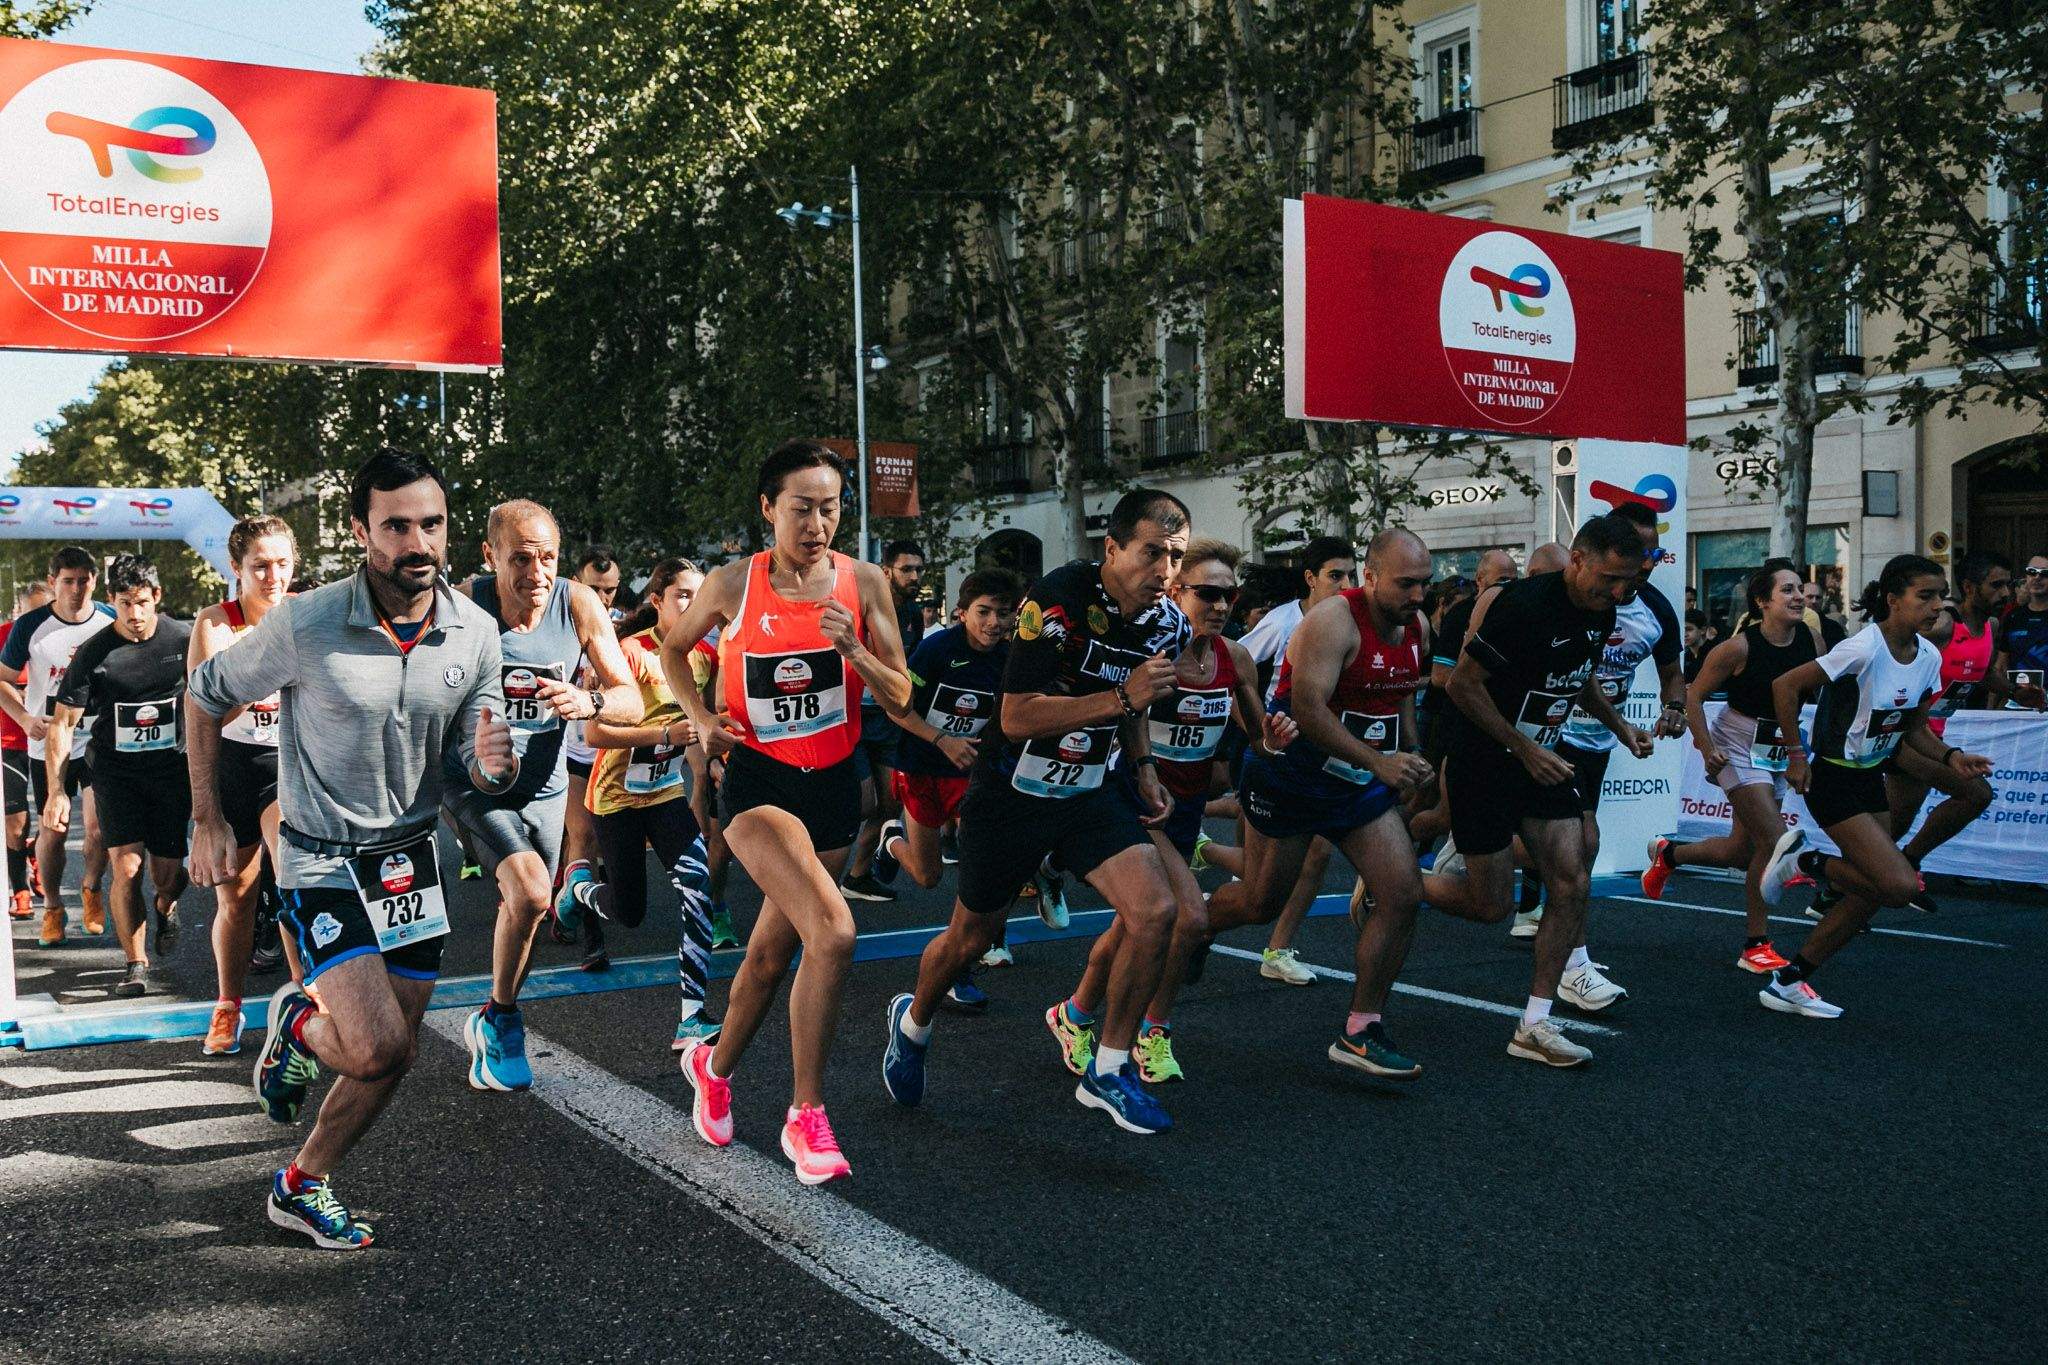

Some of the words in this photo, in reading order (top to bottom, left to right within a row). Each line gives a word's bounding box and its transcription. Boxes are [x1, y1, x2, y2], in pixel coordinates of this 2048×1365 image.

[47, 192, 220, 224] TotalEnergies
[92, 244, 173, 268] MILLA
[62, 292, 98, 313] DE
[104, 294, 204, 317] MADRID
[1472, 322, 1552, 345] TotalEnergies
[1493, 358, 1531, 375] MILLA
[1478, 391, 1496, 405] DE
[1498, 393, 1545, 410] MADRID
[1428, 484, 1498, 506] GEOX
[1632, 691, 1657, 699] balance
[505, 699, 538, 720] 215
[773, 693, 820, 723] 578
[1203, 701, 1226, 715] 3185
[134, 727, 160, 743] 210
[942, 715, 975, 733] 205
[1169, 725, 1204, 747] 185
[648, 759, 671, 781] 194
[1041, 760, 1084, 786] 212
[2005, 790, 2036, 803] que
[382, 892, 426, 928] 232
